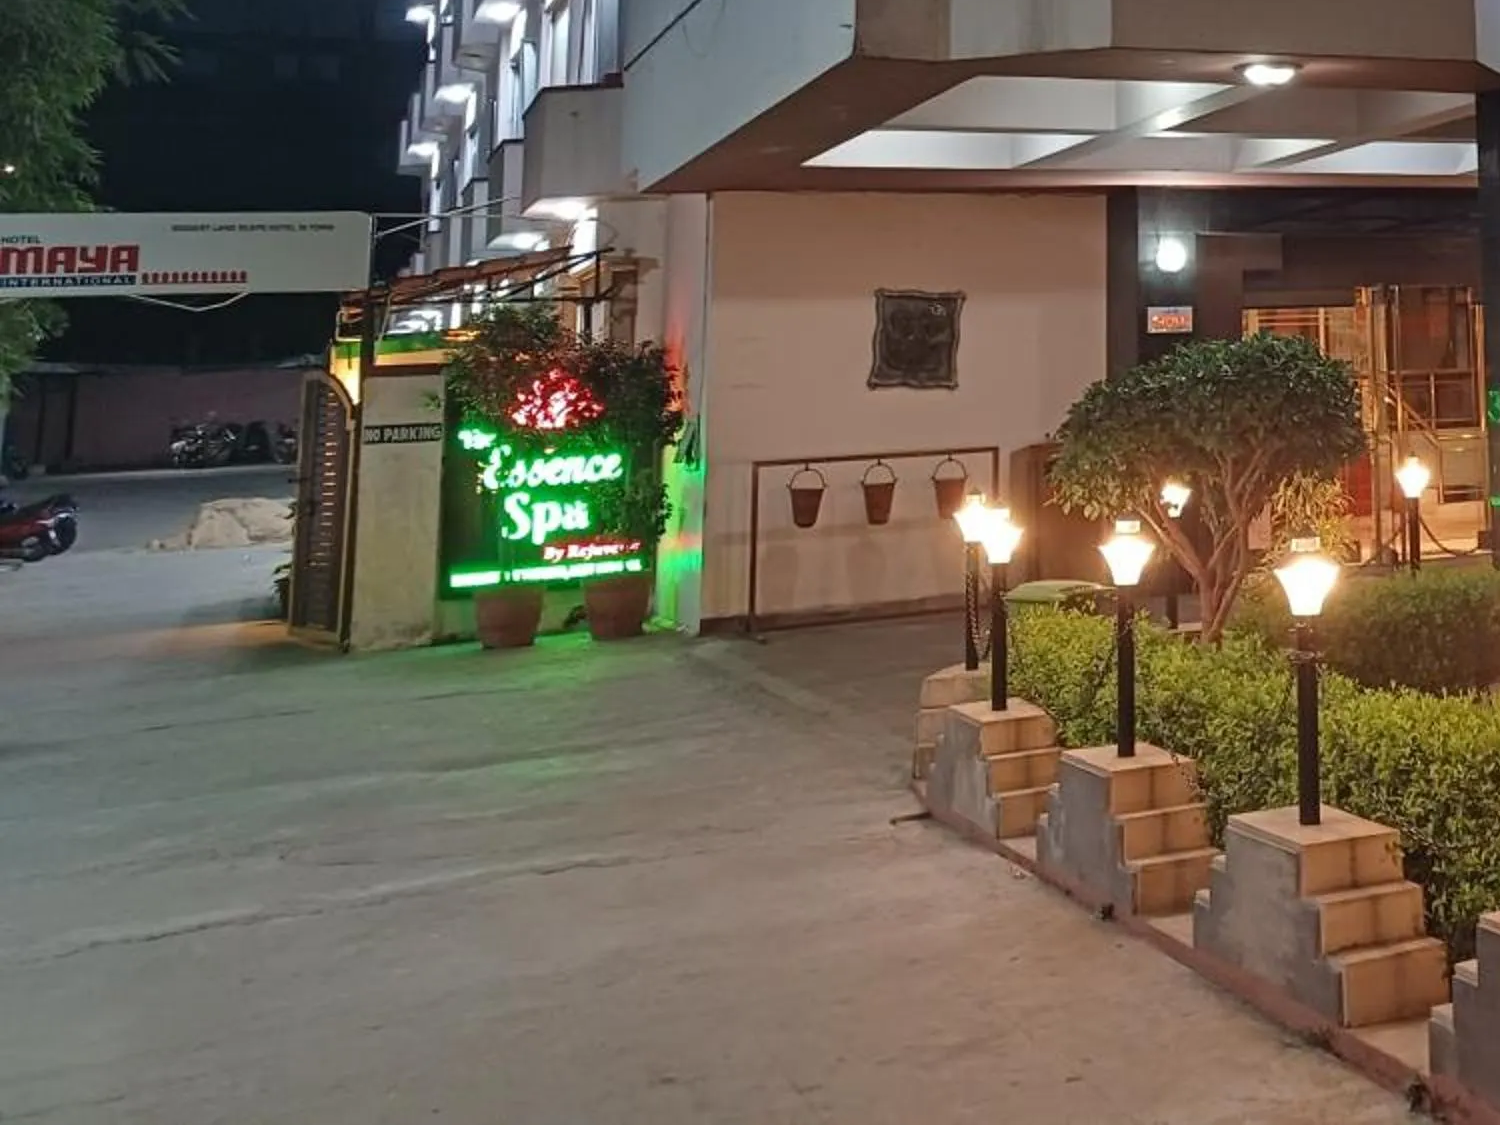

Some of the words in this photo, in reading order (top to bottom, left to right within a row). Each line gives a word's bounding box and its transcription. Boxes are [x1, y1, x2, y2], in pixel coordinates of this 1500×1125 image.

[1, 234, 41, 244] HOTEL
[0, 244, 139, 274] MAYA
[366, 428, 381, 442] NO
[383, 425, 443, 441] PARKING
[483, 444, 624, 490] Essence
[501, 491, 590, 545] Spa
